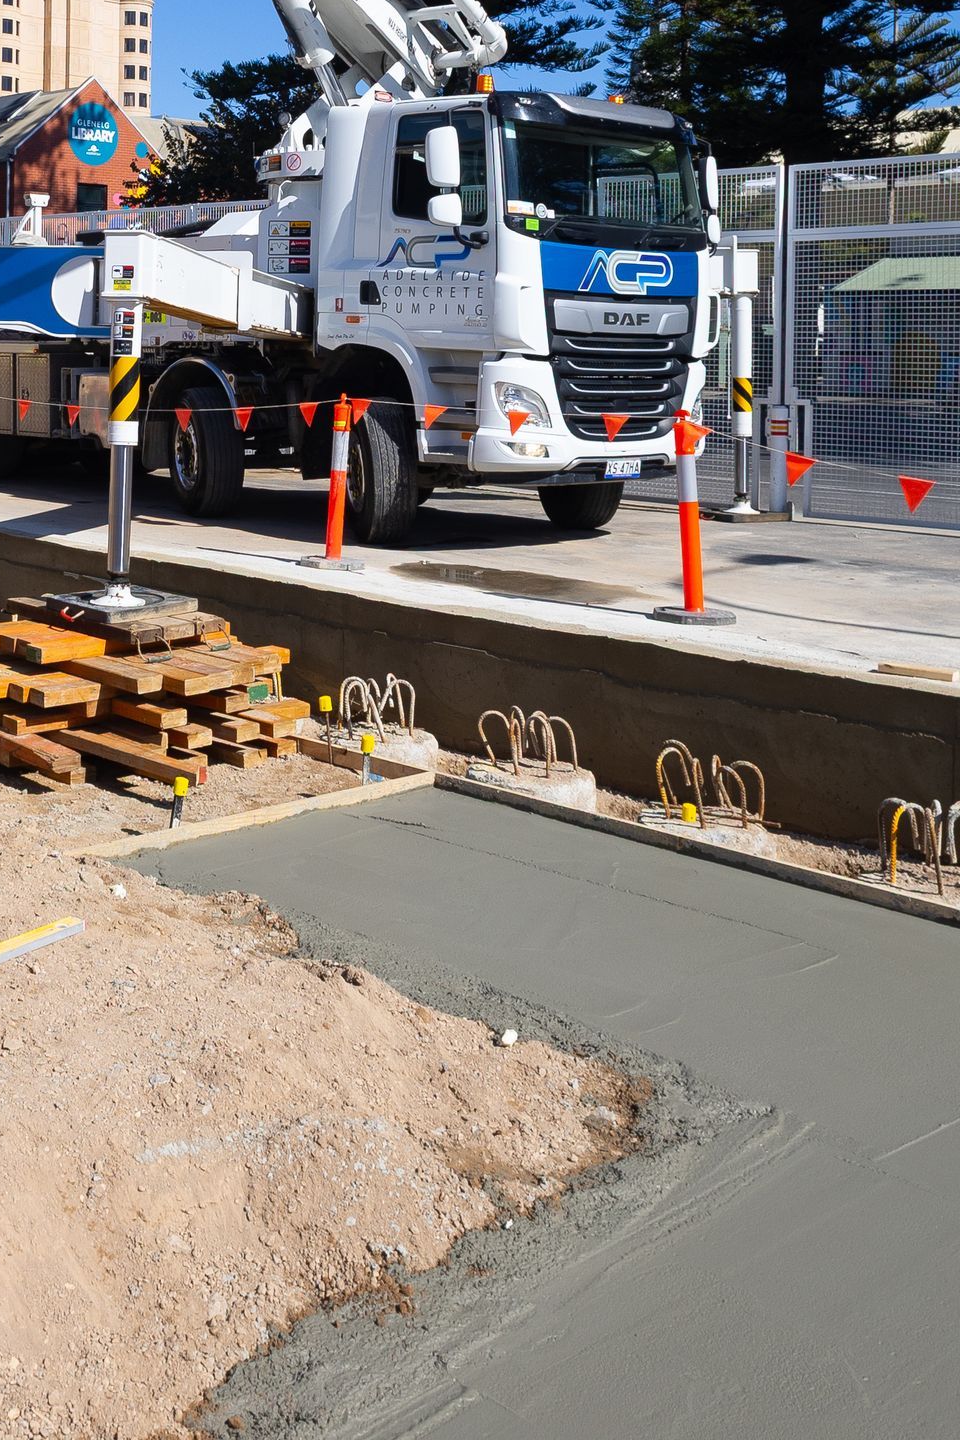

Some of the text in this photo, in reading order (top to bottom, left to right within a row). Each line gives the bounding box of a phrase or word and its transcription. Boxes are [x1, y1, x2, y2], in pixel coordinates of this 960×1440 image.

[76, 118, 110, 130] GLENELG
[71, 126, 116, 144] LIBRARY
[376, 236, 472, 269] ACP
[382, 269, 486, 281] ADELAIDE
[577, 249, 674, 296] ACP
[381, 285, 485, 299] CONCRETE
[381, 302, 484, 316] PUMPING
[603, 311, 651, 327] DAF
